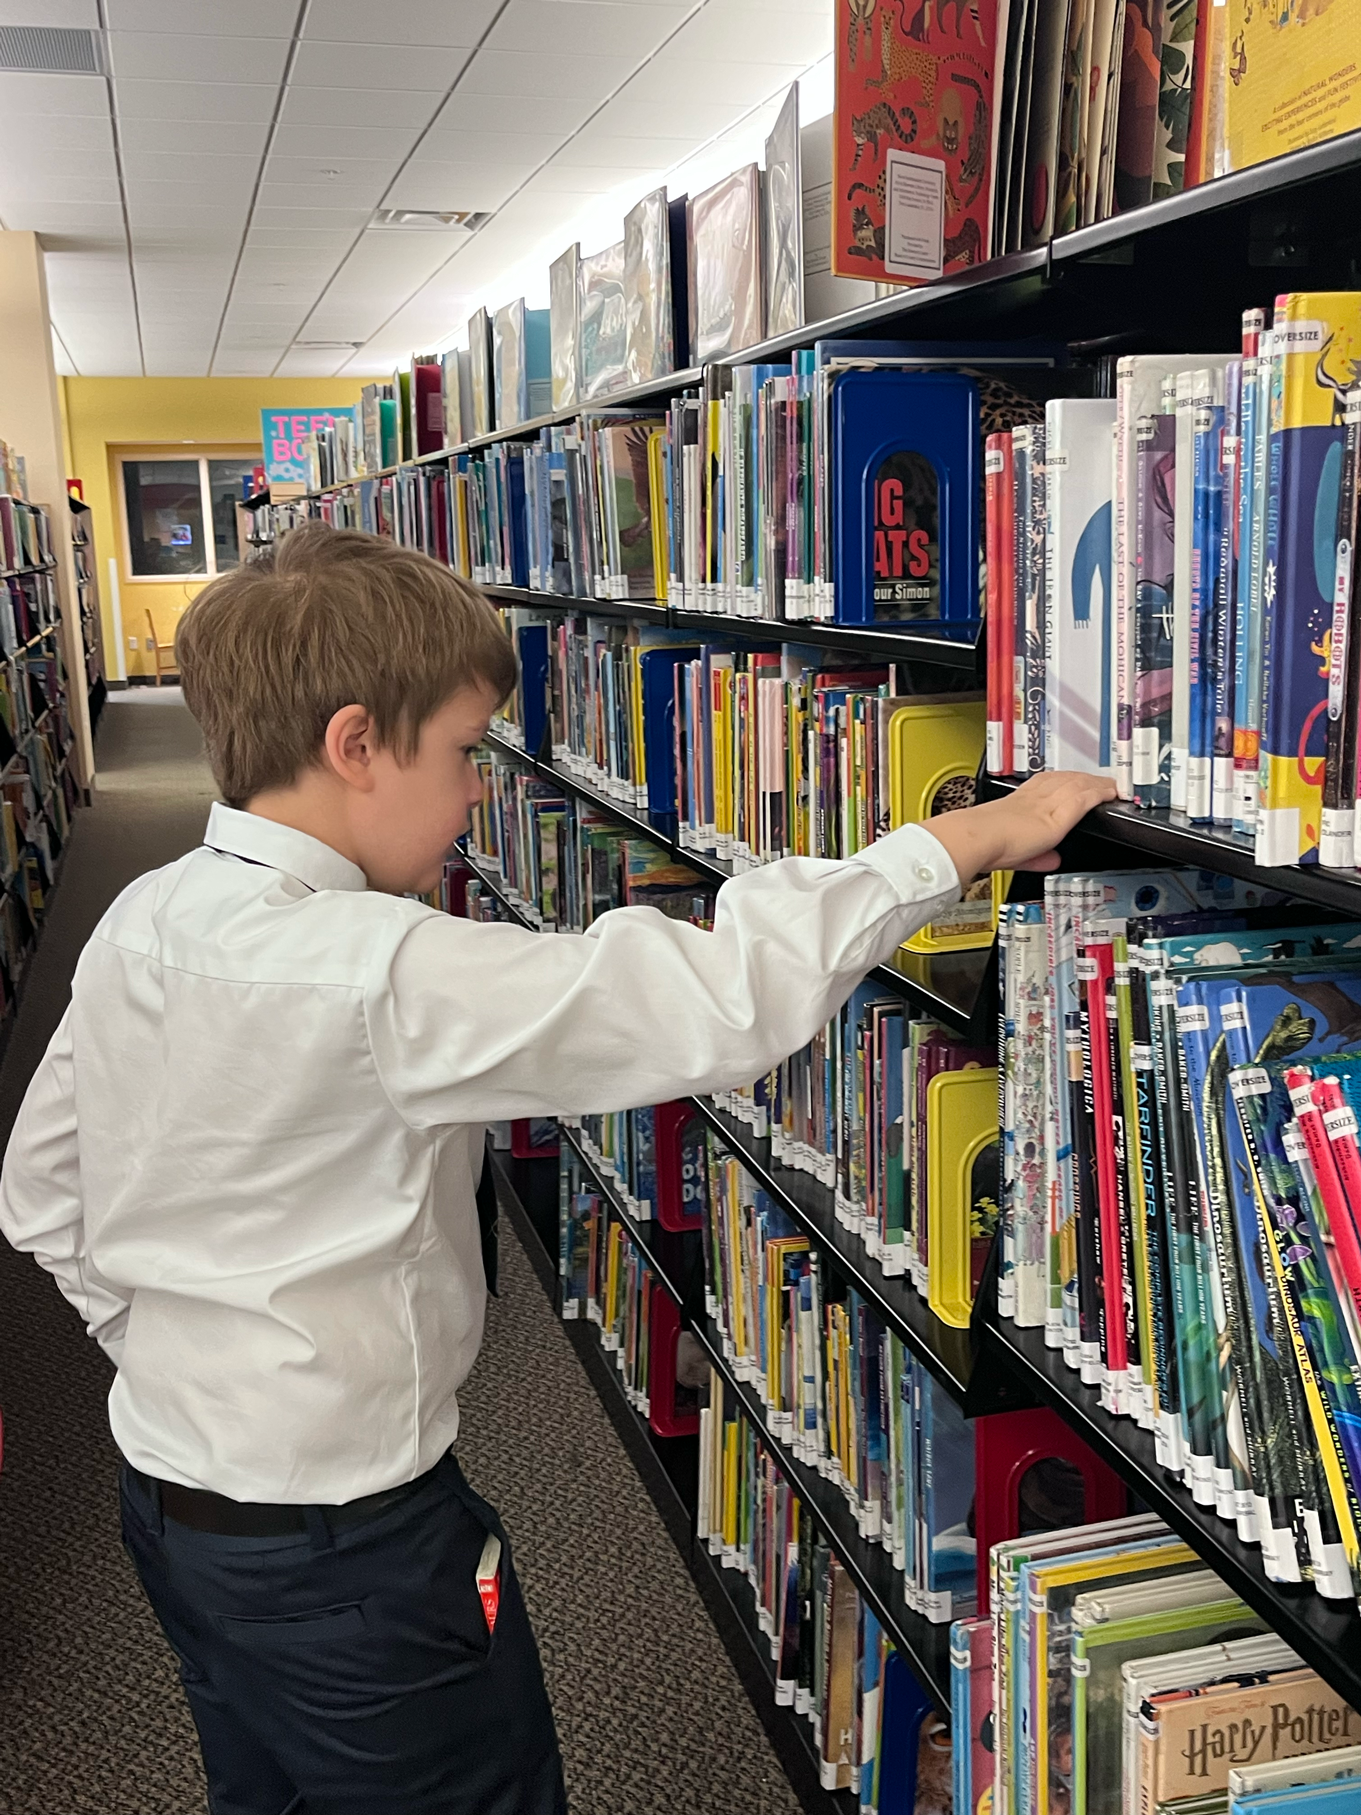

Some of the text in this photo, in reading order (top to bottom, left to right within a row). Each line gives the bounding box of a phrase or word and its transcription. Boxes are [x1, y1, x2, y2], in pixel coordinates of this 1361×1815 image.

[1274, 331, 1319, 344] OVERSIZE
[1117, 502, 1125, 525] THE
[1249, 434, 1264, 614] FABLES ARNOLD LOBEL
[1044, 548, 1054, 572] THE
[1117, 530, 1125, 565] LAST
[894, 583, 931, 600] Simon
[1117, 571, 1125, 593] OF
[1117, 600, 1125, 625] THE
[1331, 575, 1346, 685] MY ROBOTS
[1044, 620, 1054, 661] GIANT
[1234, 602, 1244, 685] HOLLING
[1190, 661, 1199, 684] WAR
[1215, 682, 1224, 713] Tale
[1078, 1010, 1094, 1113] MYTHOLOGICA
[1178, 1048, 1190, 1112] BAKER-SMITH
[1232, 1076, 1268, 1089] OVERSIZE
[1236, 1097, 1253, 1140] JENNIFER
[1135, 1070, 1157, 1218] TARFINDER
[1070, 1151, 1082, 1219] CROSSINGS
[1166, 1171, 1176, 1207] LIFE
[1170, 1225, 1178, 1245] FIRST
[1187, 1179, 1206, 1324] LIFE THE FIRST FOUR BILLION YEARS
[1209, 1191, 1235, 1314] Dinosaurium
[1171, 1245, 1180, 1264] FOUR
[1273, 1229, 1295, 1282] GLOW
[1173, 1264, 1182, 1291] BILLION
[1175, 1291, 1184, 1314] YEARS
[1281, 1274, 1313, 1385] DINOSAUR ATLAS
[1242, 1416, 1251, 1434] and
[1290, 1428, 1299, 1446] and
[1320, 1389, 1334, 1419] WILD
[1329, 1421, 1351, 1480] WONDERS
[1181, 1717, 1267, 1777] Harry
[1270, 1702, 1352, 1760] Potter
